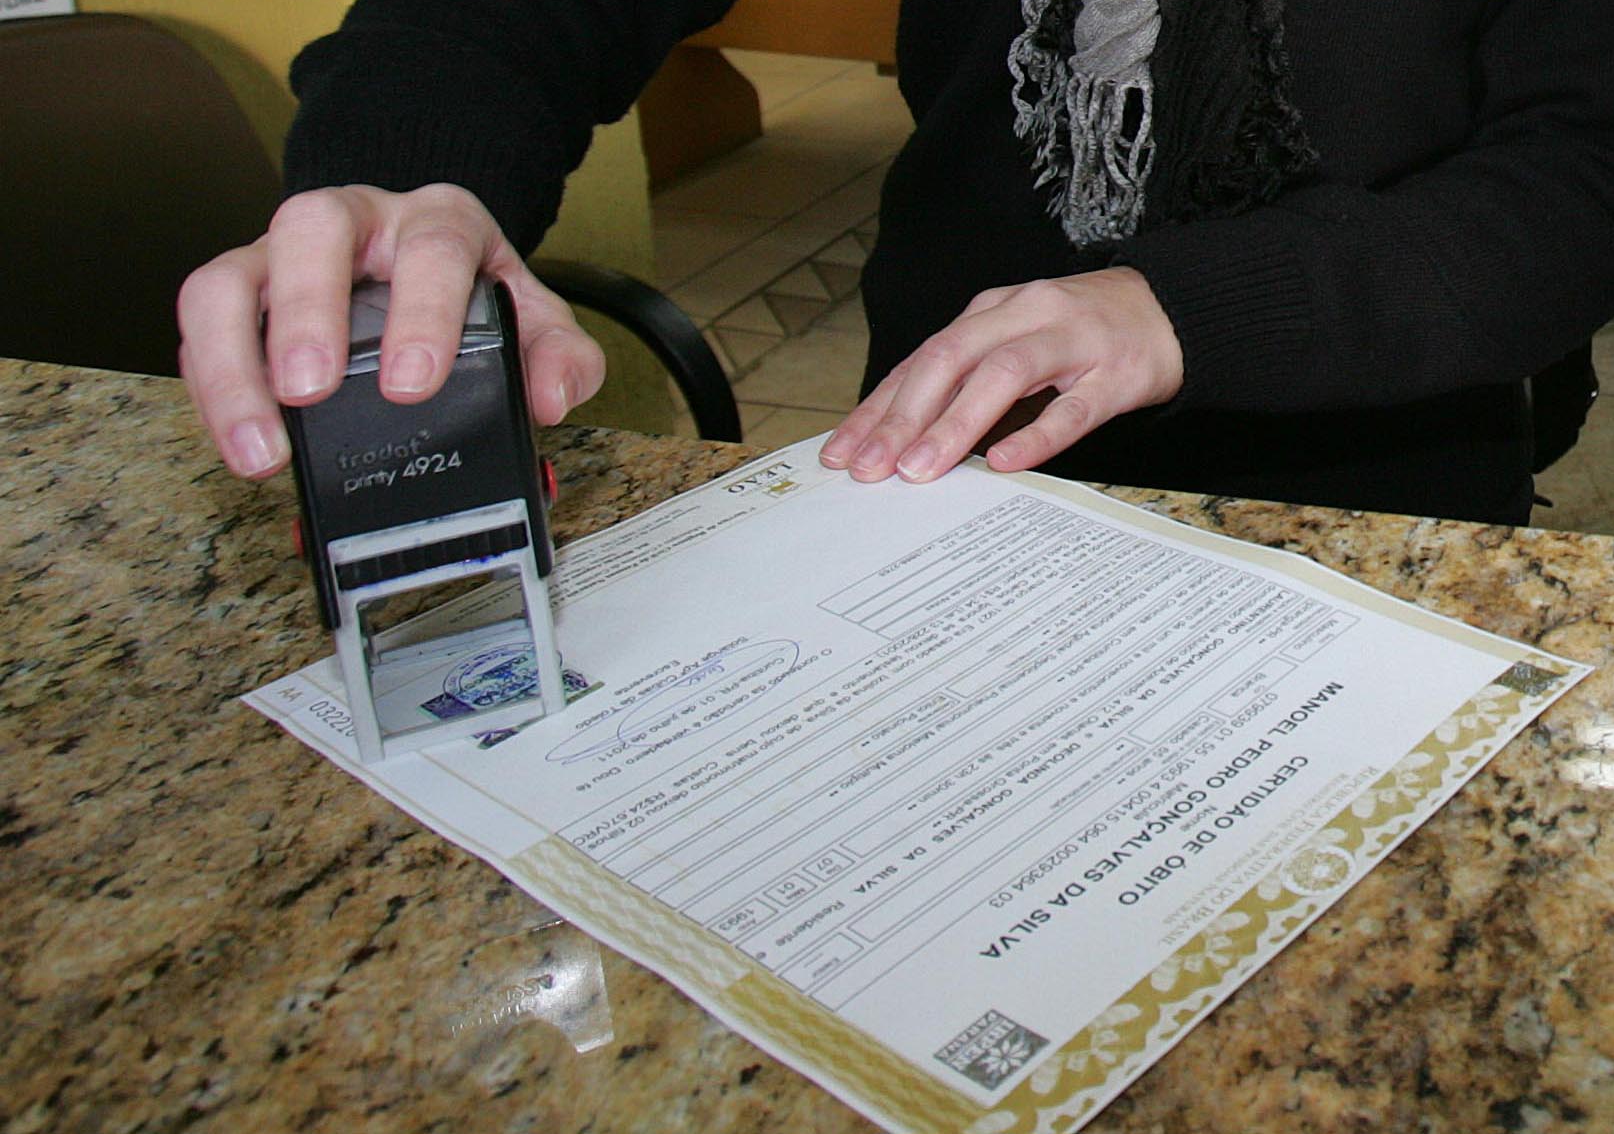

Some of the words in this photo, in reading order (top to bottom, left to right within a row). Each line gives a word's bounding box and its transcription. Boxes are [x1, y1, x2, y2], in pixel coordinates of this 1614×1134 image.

[344, 468, 398, 495] printy
[402, 450, 462, 477] 4924
[1133, 688, 1156, 701] DA
[1095, 704, 1134, 729] SILVA
[1264, 681, 1347, 738] MANOEL
[1208, 727, 1232, 741] 01
[1189, 740, 1215, 755] 55
[1014, 741, 1083, 785] DEOLINDA
[1155, 755, 1195, 781] 1993
[1199, 737, 1274, 789] PEDRO
[1144, 779, 1163, 790] 4
[1209, 754, 1314, 831] CERTIDÃO
[927, 787, 1014, 843] GONÇALVES
[1100, 788, 1152, 823] 00415
[1077, 787, 1209, 883] GONÇALVES
[1180, 829, 1218, 853] DE
[811, 856, 835, 870] 07
[900, 845, 927, 862] DA
[774, 880, 797, 894] 01
[1113, 853, 1191, 909] ÓBITO
[986, 890, 1014, 909] 03
[1045, 881, 1087, 909] DA
[716, 907, 756, 932] 1993
[977, 907, 1053, 962] SILVA
